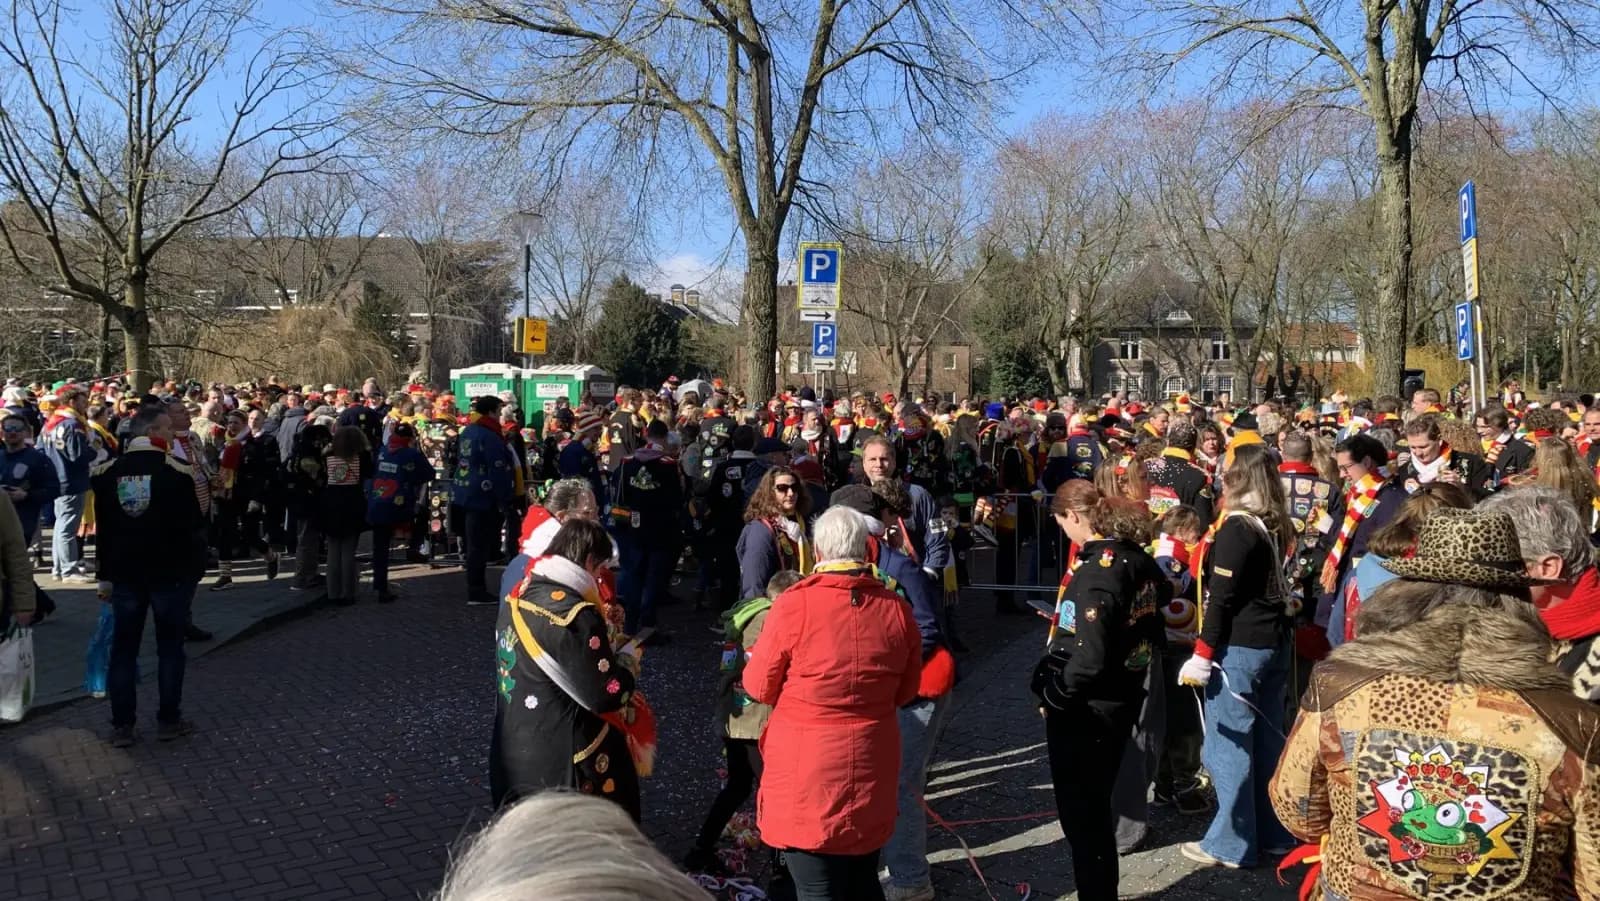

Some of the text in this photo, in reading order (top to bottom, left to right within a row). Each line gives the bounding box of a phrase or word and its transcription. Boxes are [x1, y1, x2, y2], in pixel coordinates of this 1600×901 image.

[1462, 193, 1469, 238] P
[811, 253, 831, 280] P
[819, 325, 832, 343] P
[1458, 308, 1467, 337] P
